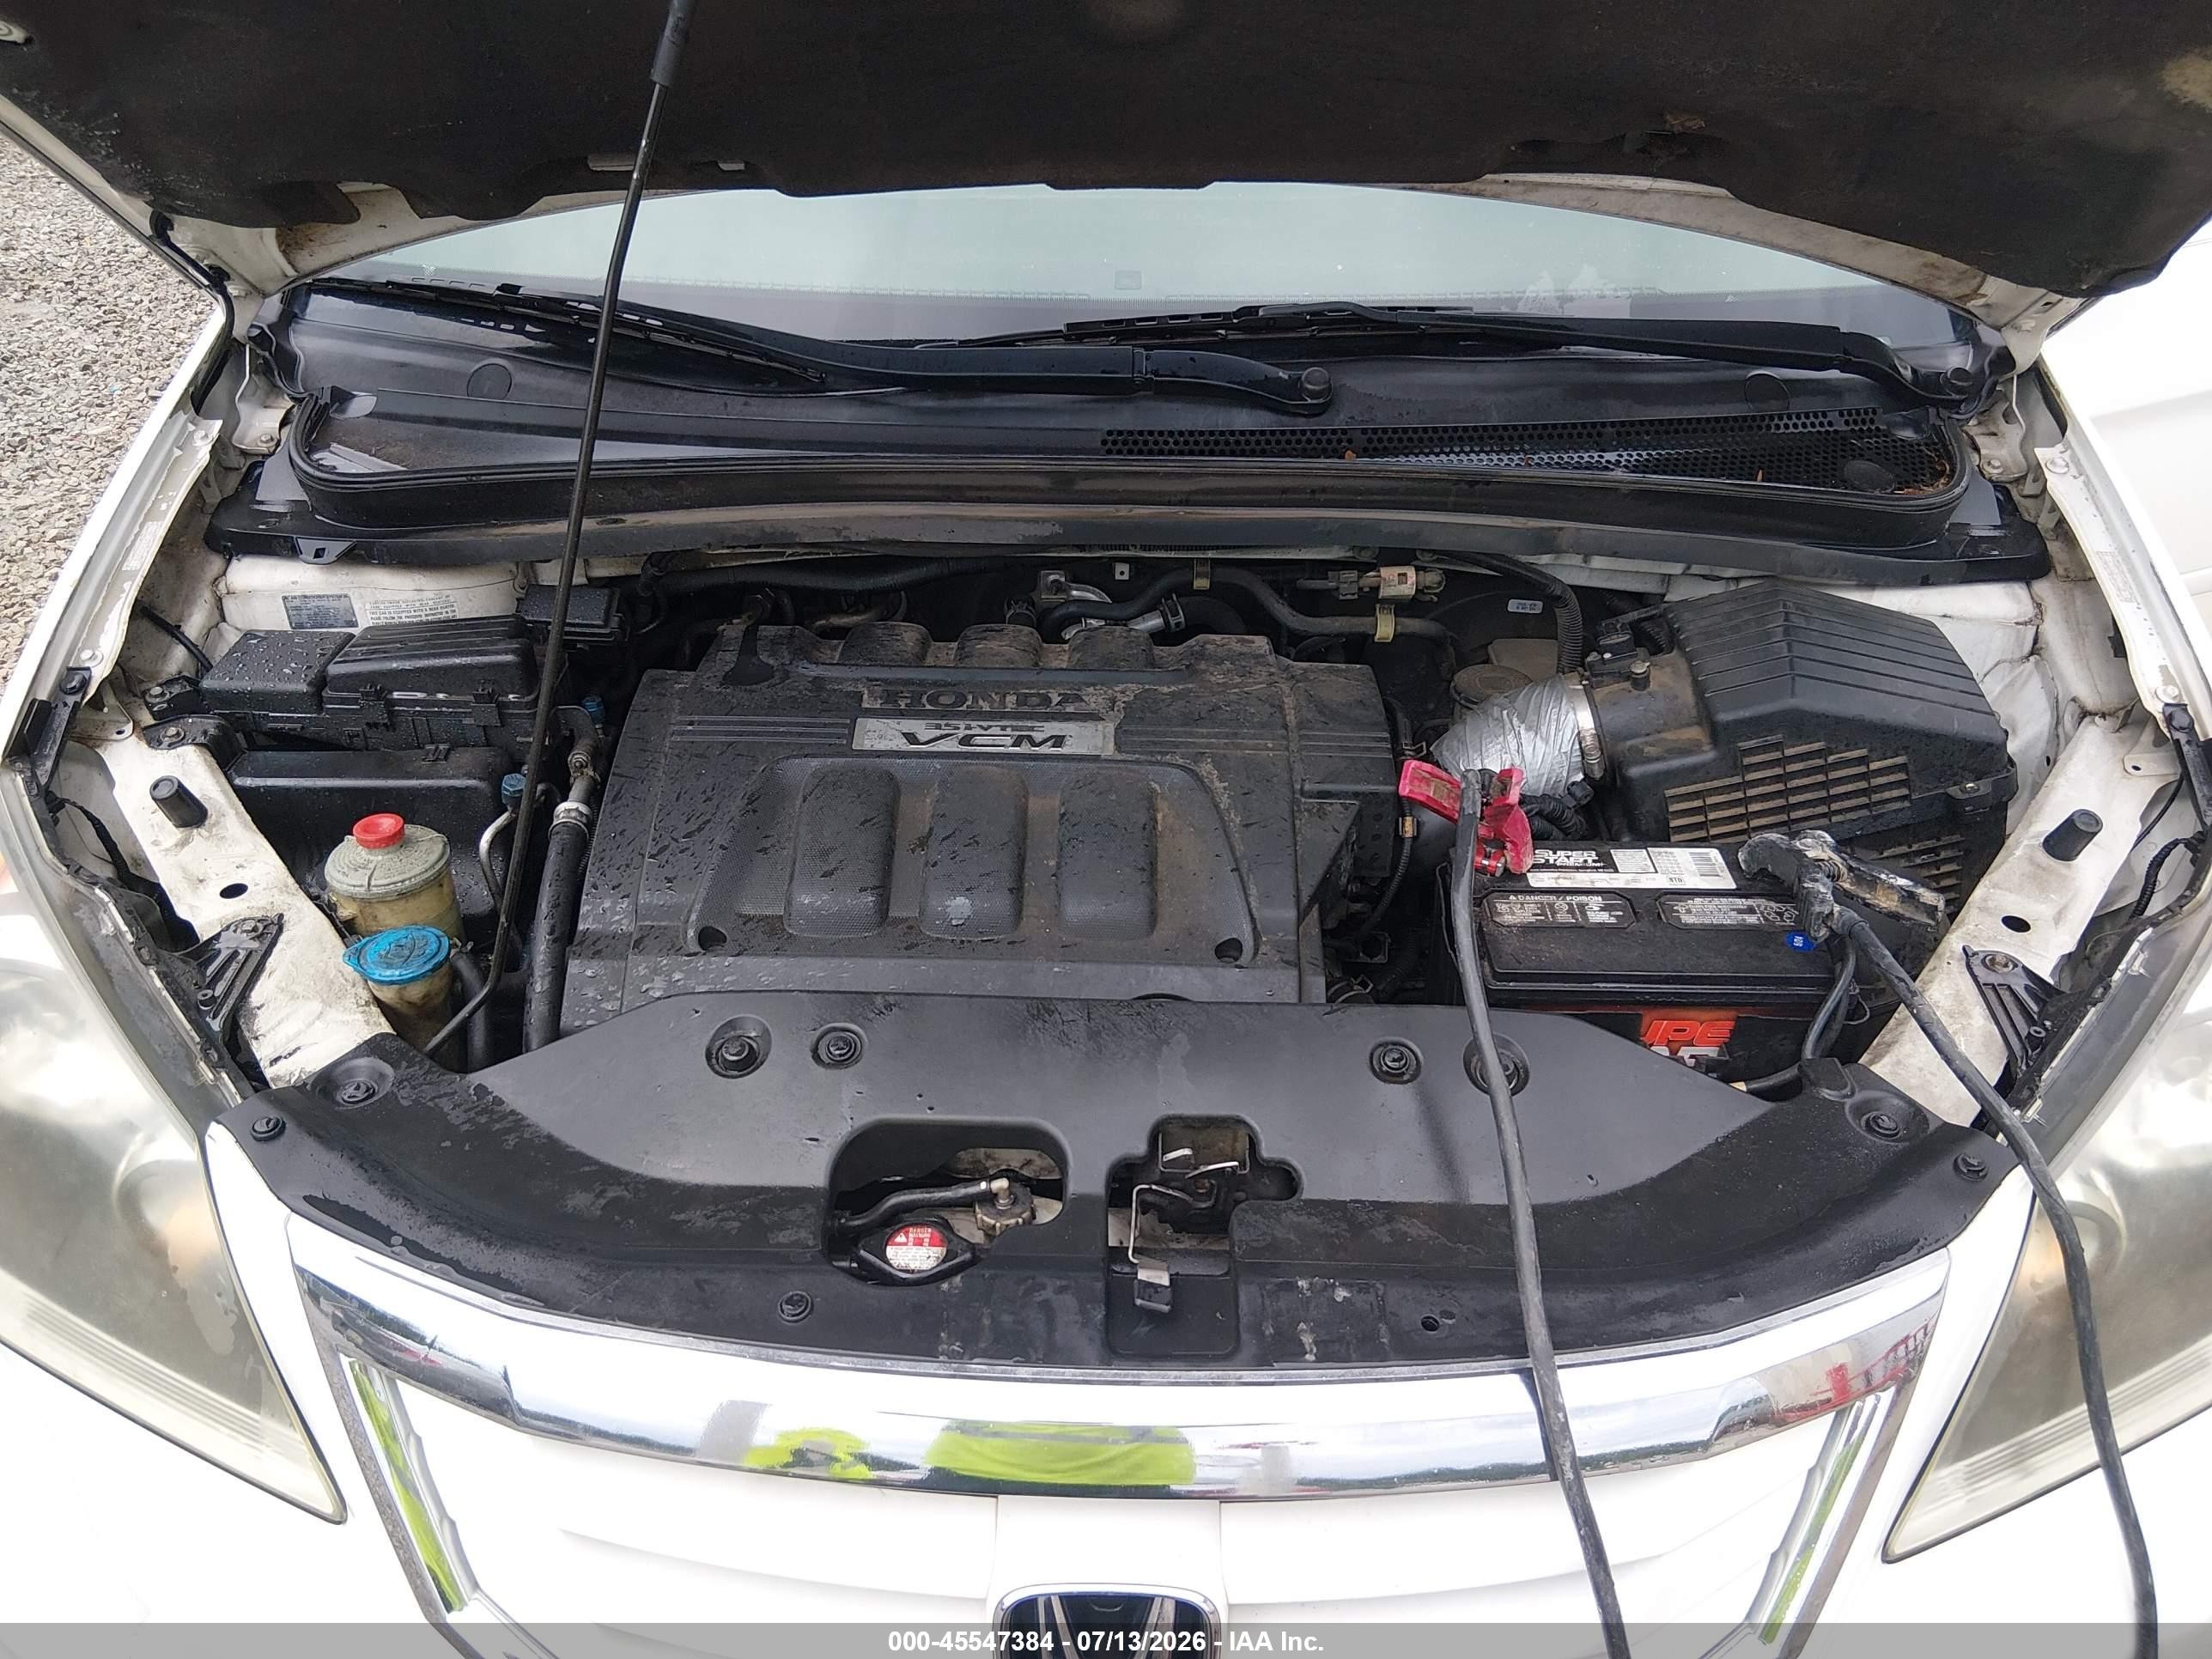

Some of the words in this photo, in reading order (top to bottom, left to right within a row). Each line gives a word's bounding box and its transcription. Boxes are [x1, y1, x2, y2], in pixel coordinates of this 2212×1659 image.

[877, 690, 1089, 709] HONDA
[901, 731, 1066, 750] VCM
[1533, 848, 1596, 858] SUPER
[1532, 856, 1598, 865] START
